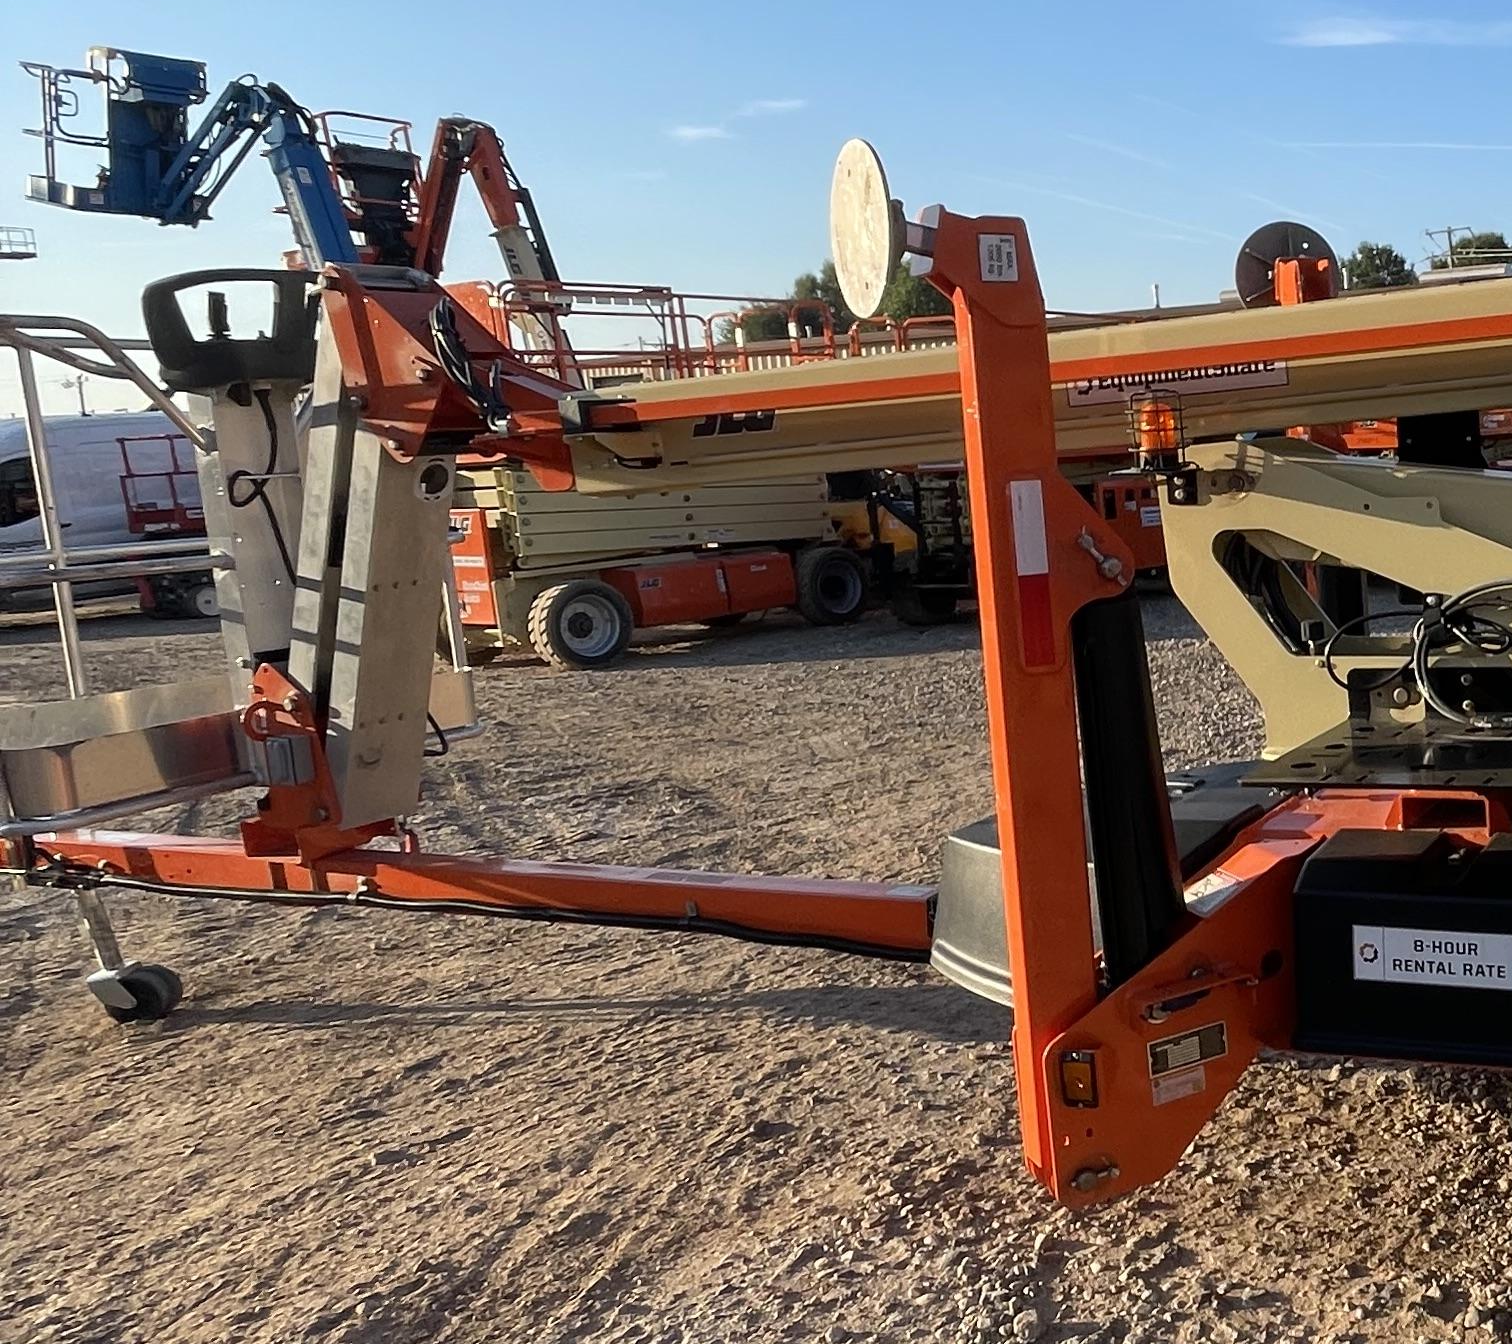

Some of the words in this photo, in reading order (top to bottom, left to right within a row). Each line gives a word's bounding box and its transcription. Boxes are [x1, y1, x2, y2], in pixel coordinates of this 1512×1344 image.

[1413, 939, 1478, 956] 8-HOUR
[1392, 958, 1456, 975] RENTAL
[1463, 963, 1506, 979] RATE
